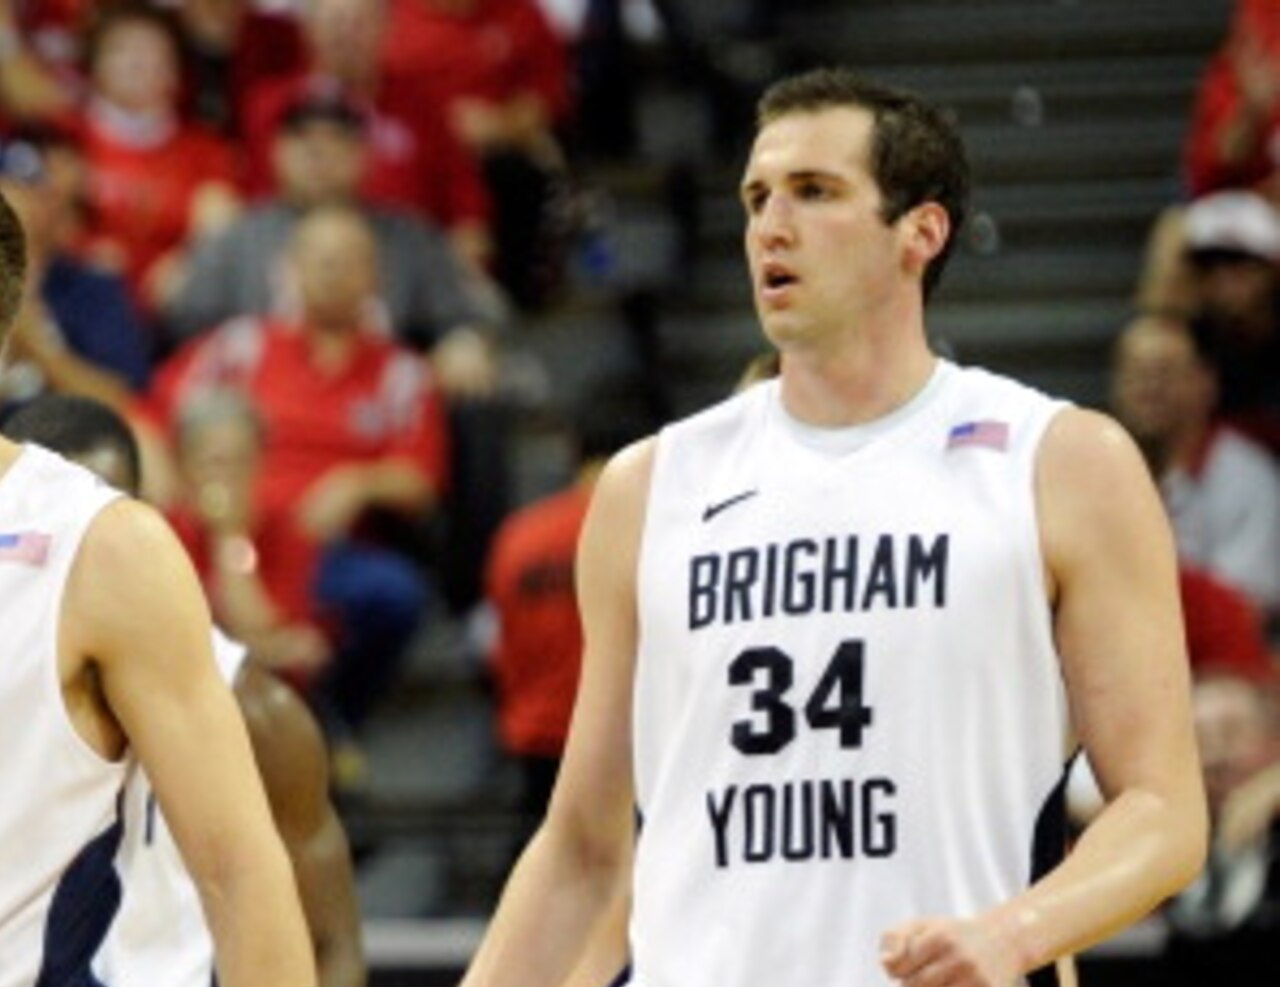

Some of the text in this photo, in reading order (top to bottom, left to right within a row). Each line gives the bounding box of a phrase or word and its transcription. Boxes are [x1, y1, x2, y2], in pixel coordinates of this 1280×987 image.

[689, 534, 949, 630] BRIGHAM
[728, 639, 873, 756] 34
[707, 777, 897, 868] YOUNG
